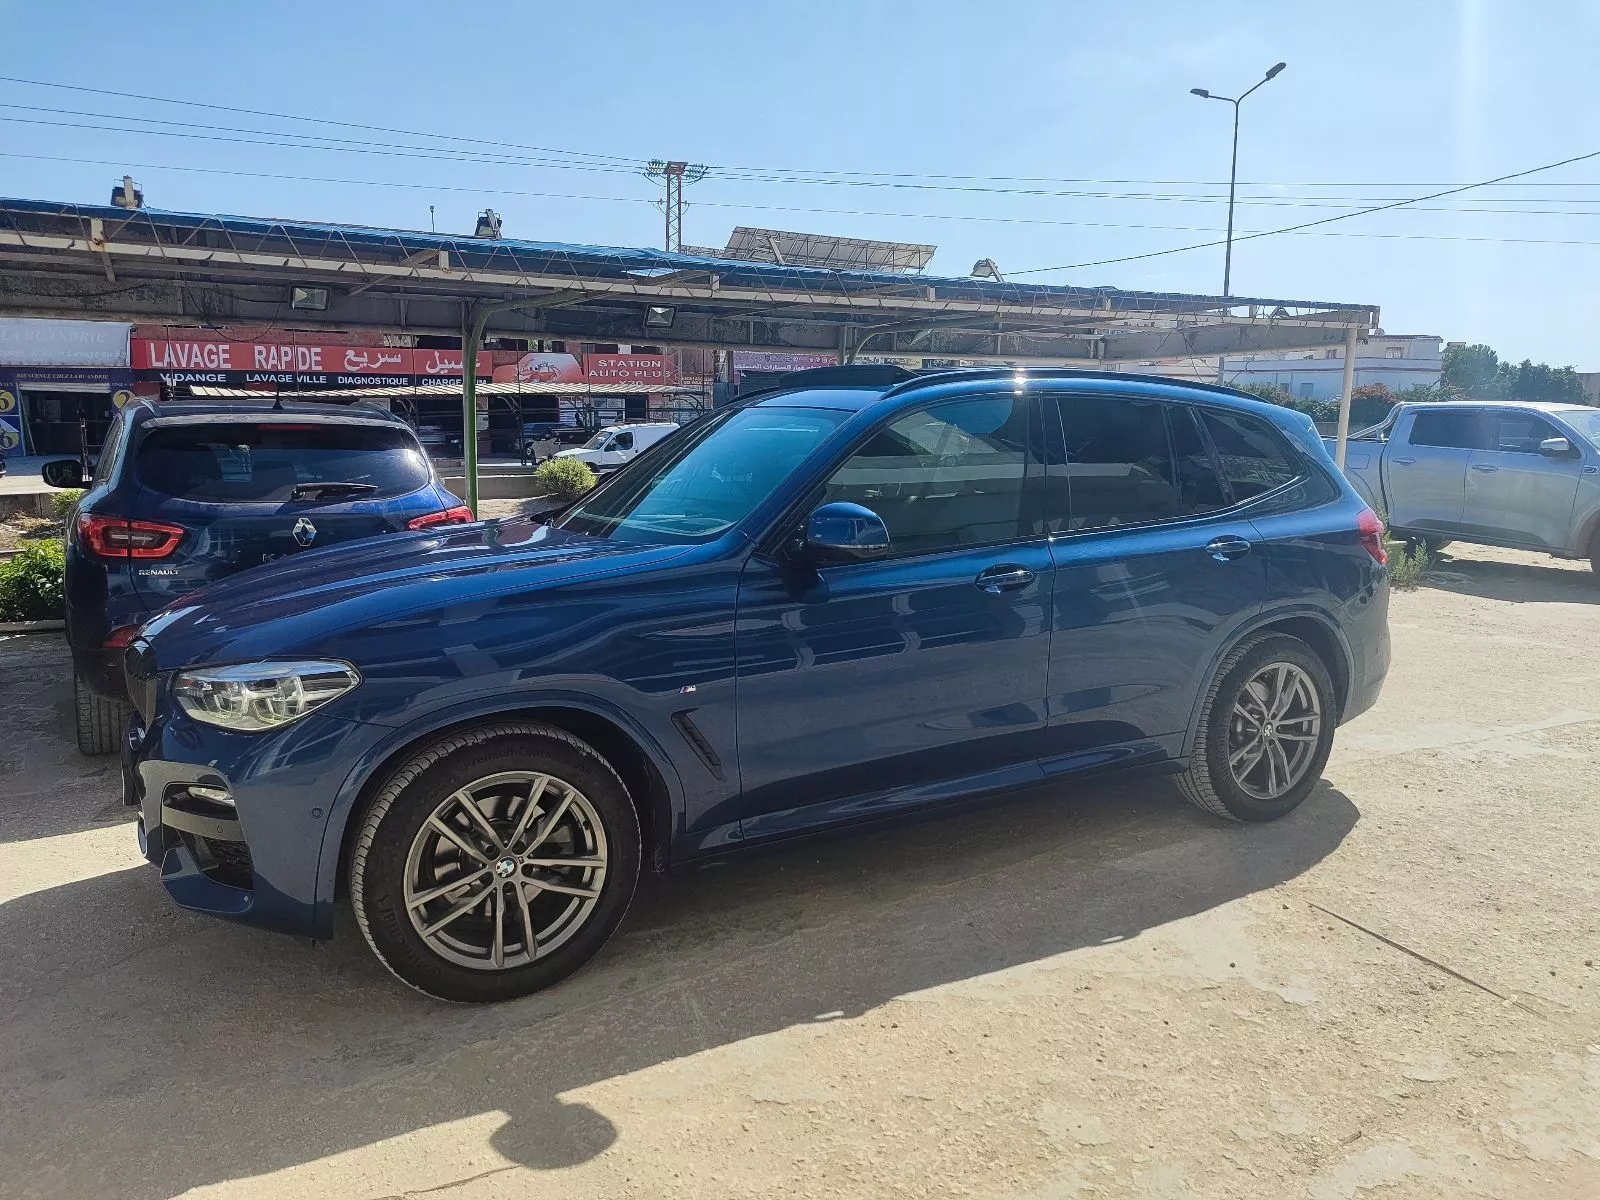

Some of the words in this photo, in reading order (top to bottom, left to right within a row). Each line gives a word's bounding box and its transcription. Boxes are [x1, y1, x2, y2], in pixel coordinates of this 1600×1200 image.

[150, 343, 231, 369] LAVAGE
[254, 345, 323, 371] RAPIDE
[344, 349, 402, 372] سريع
[426, 351, 481, 374] سيل
[598, 359, 661, 368] STATION
[159, 373, 227, 382] VDANGE
[589, 369, 629, 378] AUTO
[634, 370, 671, 378] PLUS
[246, 373, 294, 383] LAVAGE
[297, 375, 327, 384] VILLE
[338, 376, 409, 386] DIAGNOSTIQUE
[422, 378, 462, 387] CHARGE
[138, 569, 181, 577] RENAULT
